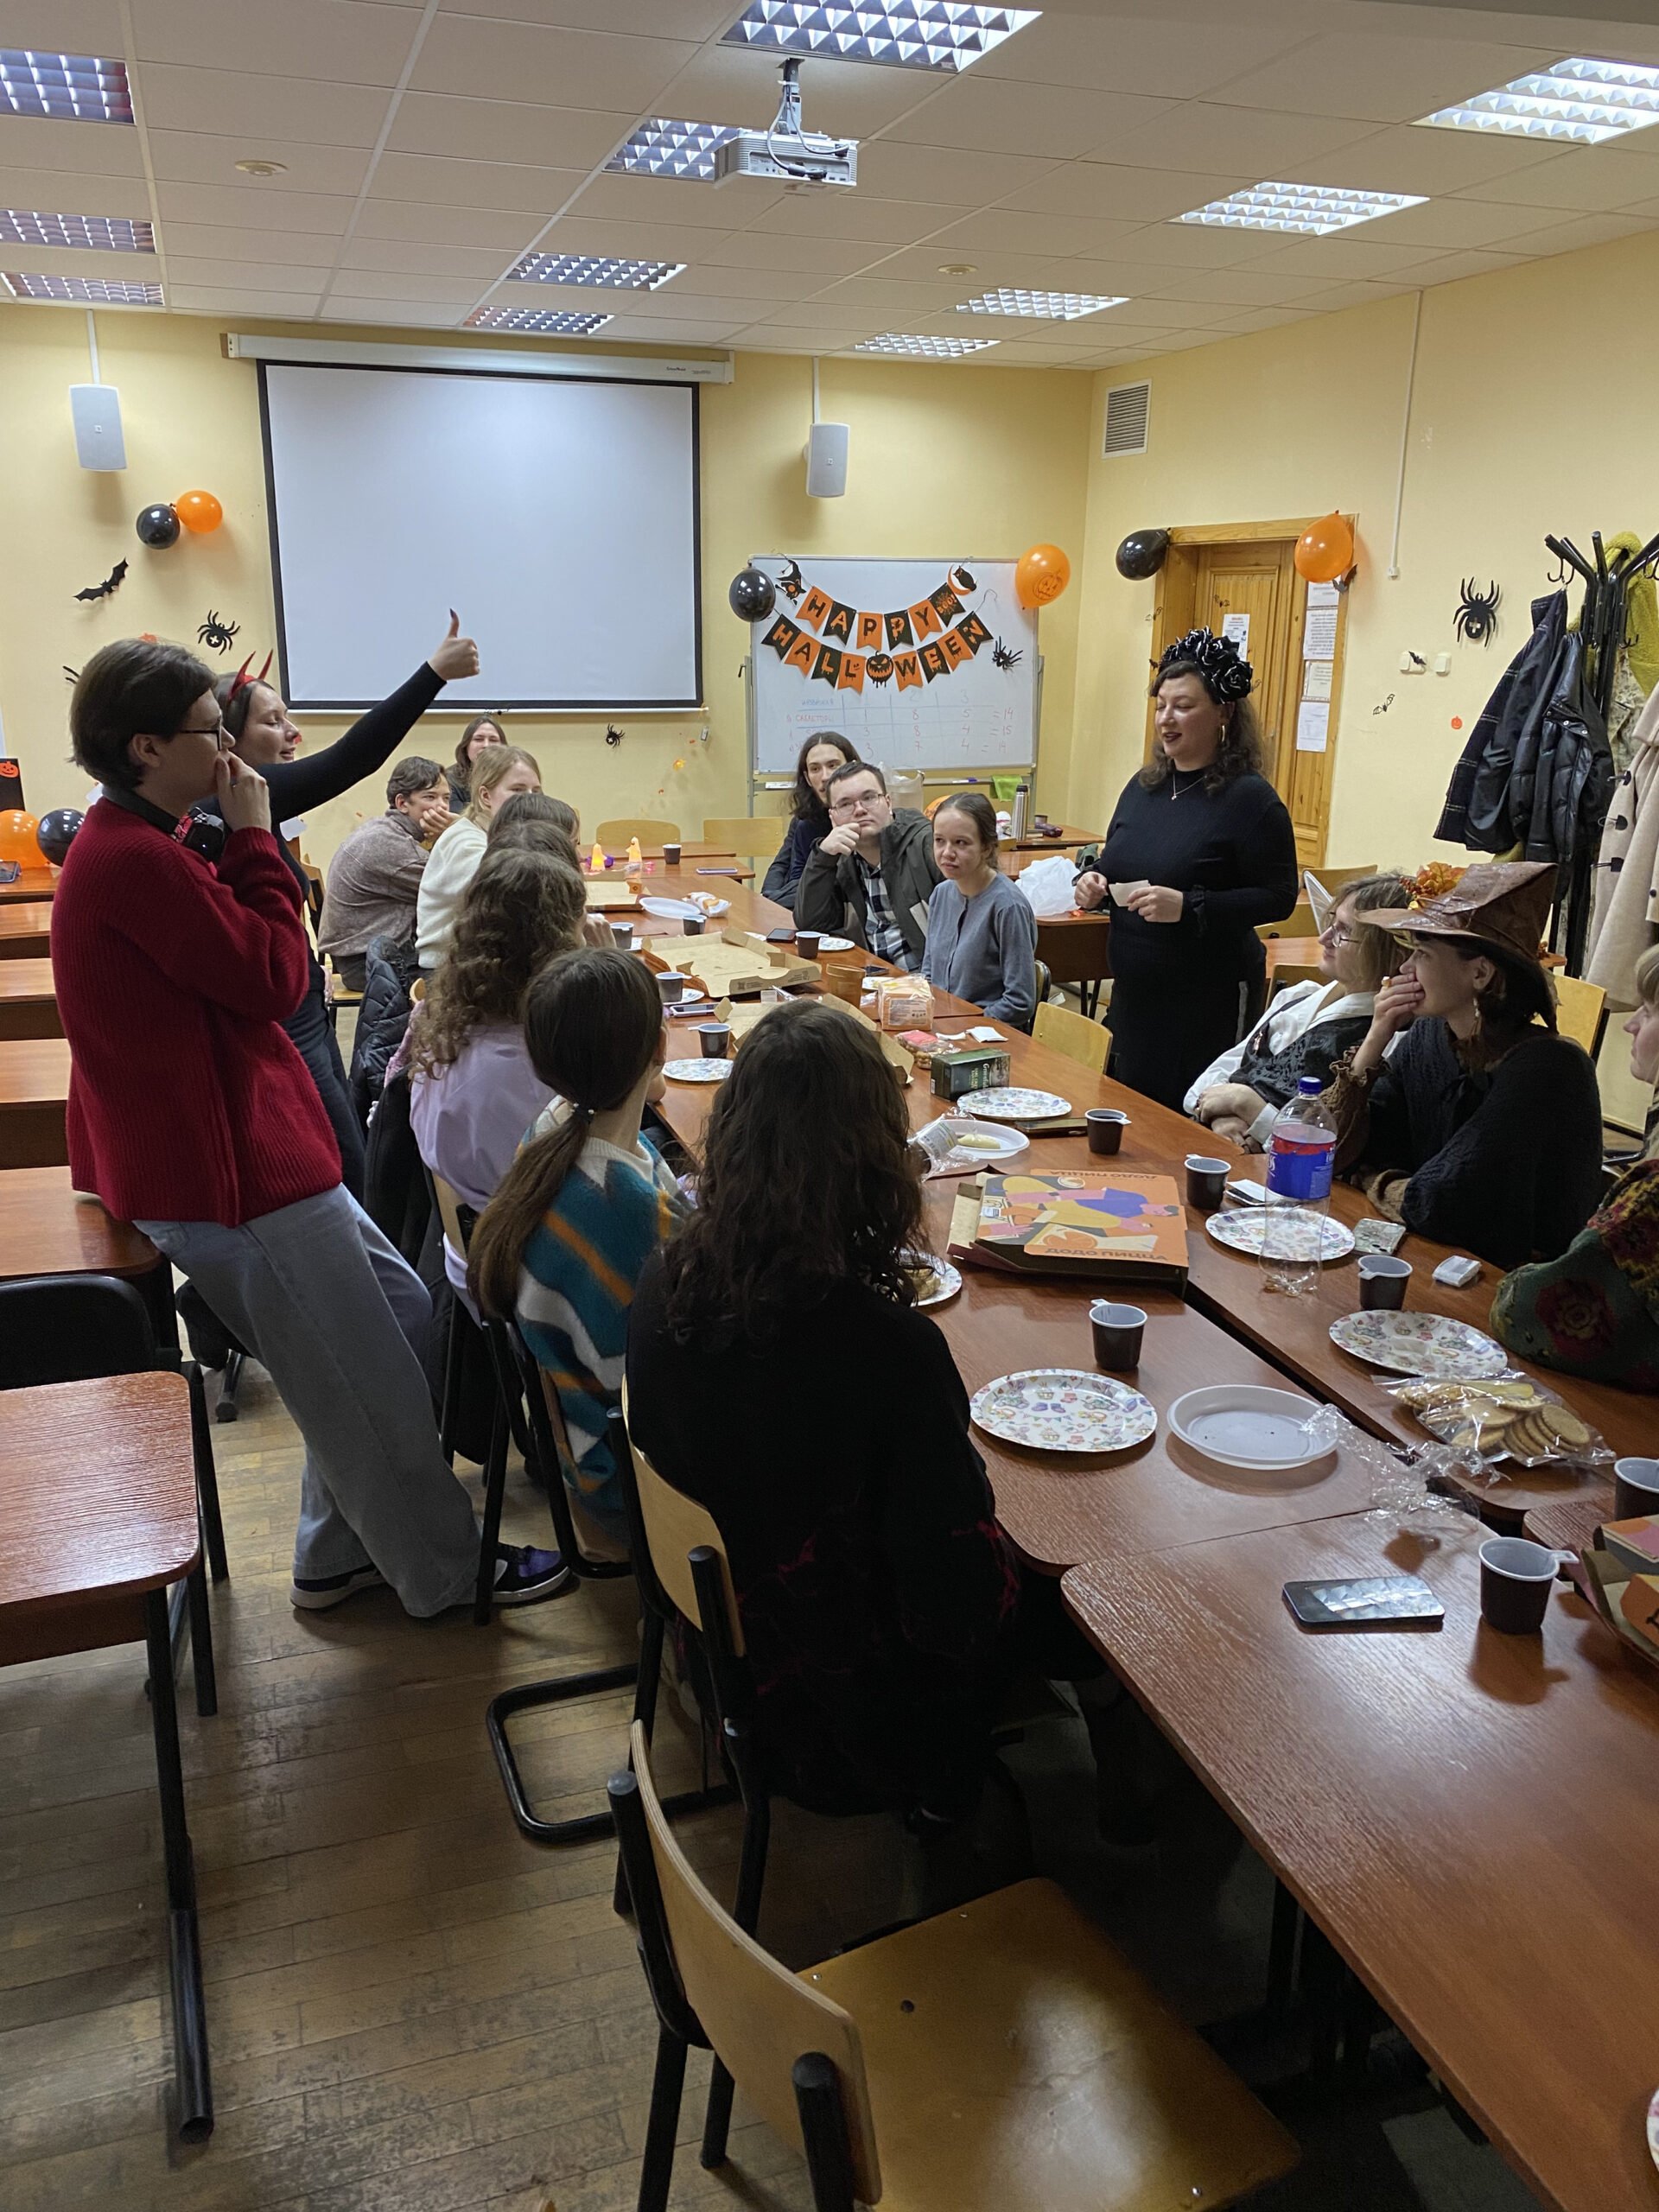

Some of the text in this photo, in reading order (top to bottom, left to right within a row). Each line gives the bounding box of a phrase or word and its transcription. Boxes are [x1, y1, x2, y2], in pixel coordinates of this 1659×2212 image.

[808, 594, 930, 641] HAPPY
[912, 709, 919, 720] 8
[963, 709, 970, 719] 5
[1003, 708, 1014, 720] 14
[864, 727, 870, 737] 3
[914, 725, 921, 736] 8
[1045, 1247, 1168, 1261] ДОДО ПИЦЦА
